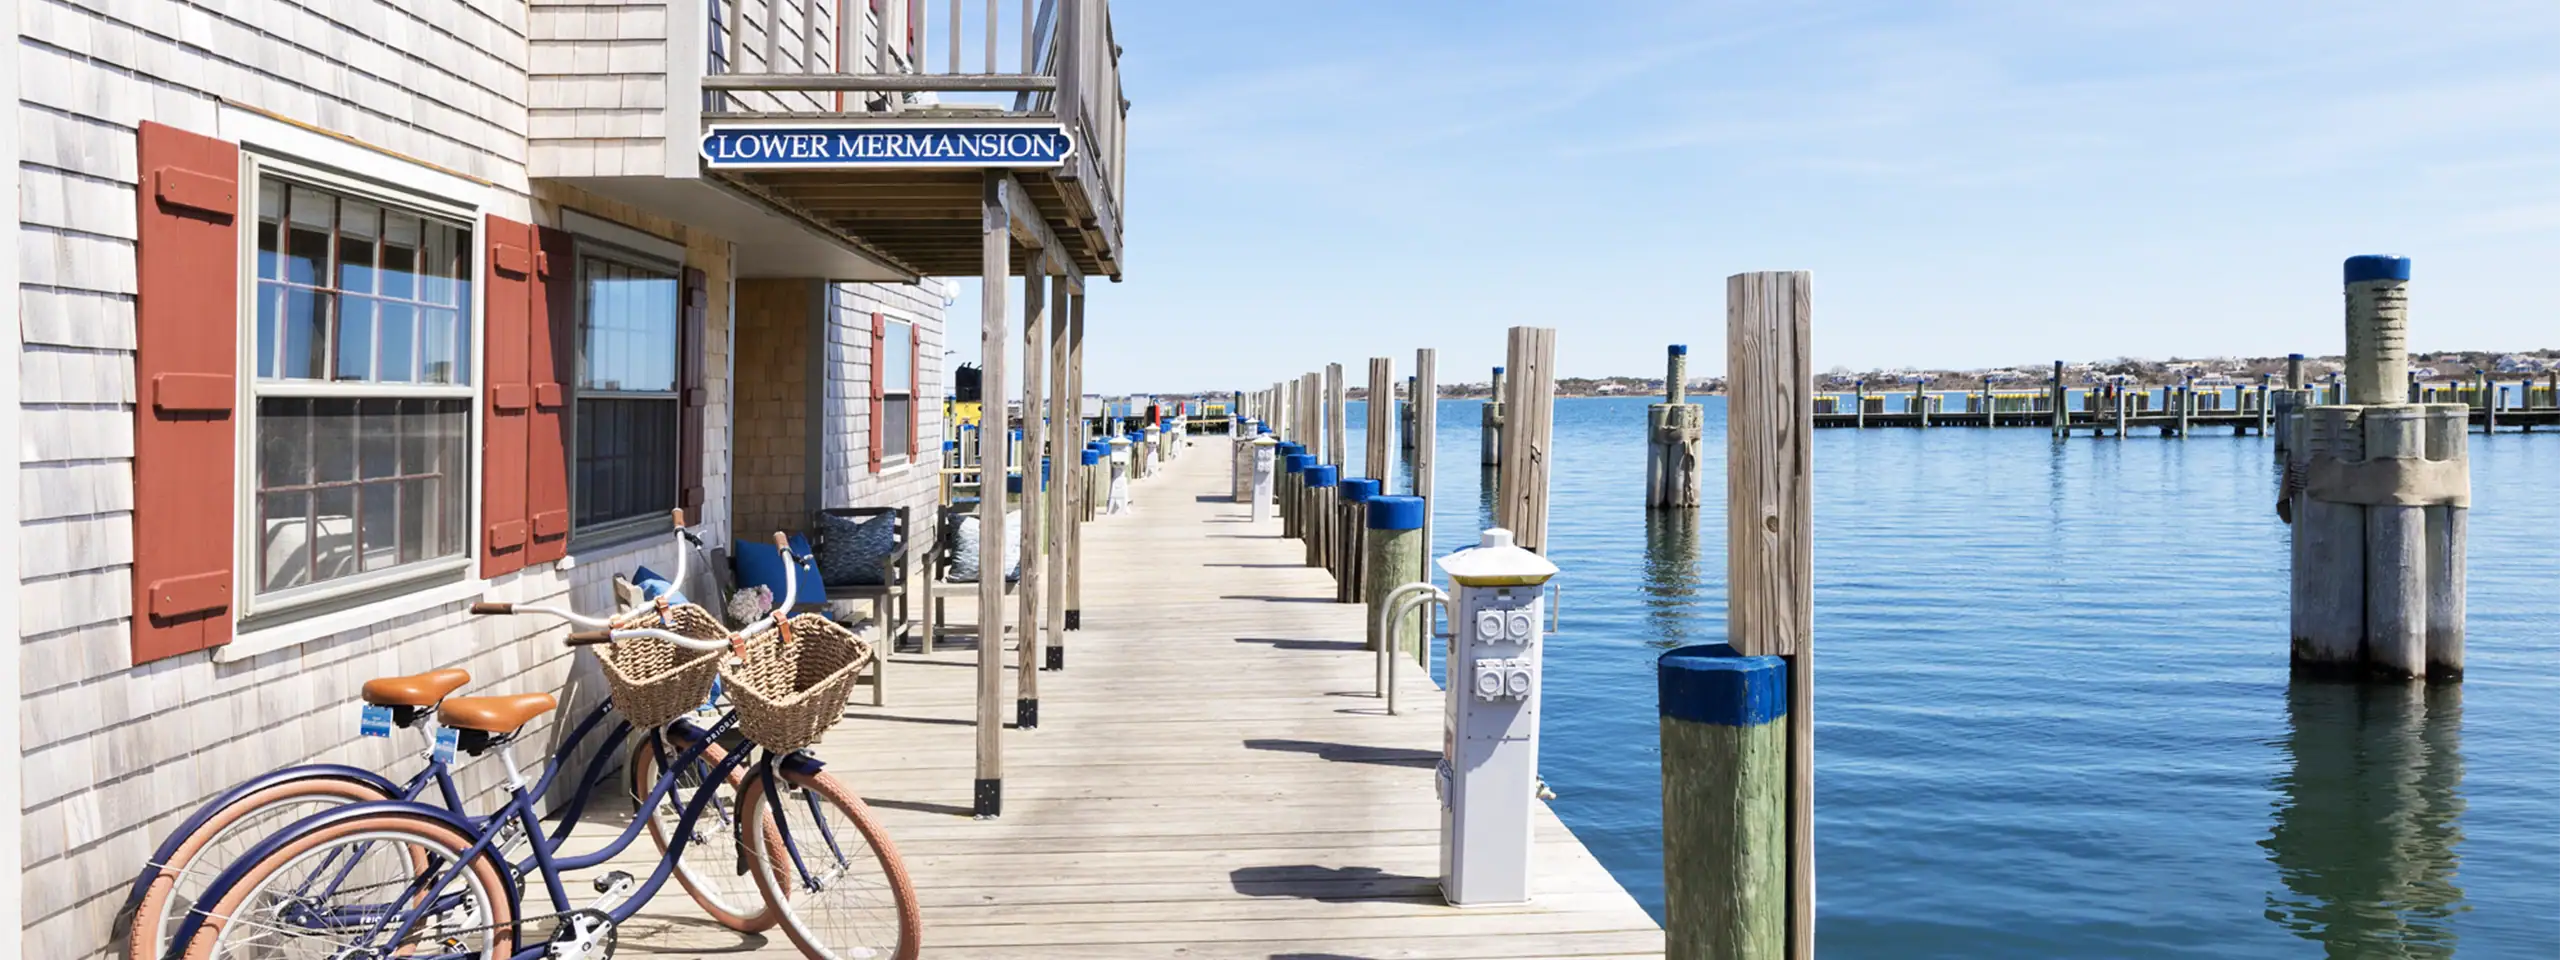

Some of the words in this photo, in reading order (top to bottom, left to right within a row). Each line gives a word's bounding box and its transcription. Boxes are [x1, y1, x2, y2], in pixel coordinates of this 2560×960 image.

[718, 135, 828, 159] LOWER
[837, 133, 1056, 158] MERMANSION
[705, 714, 738, 744] PRIORIT
